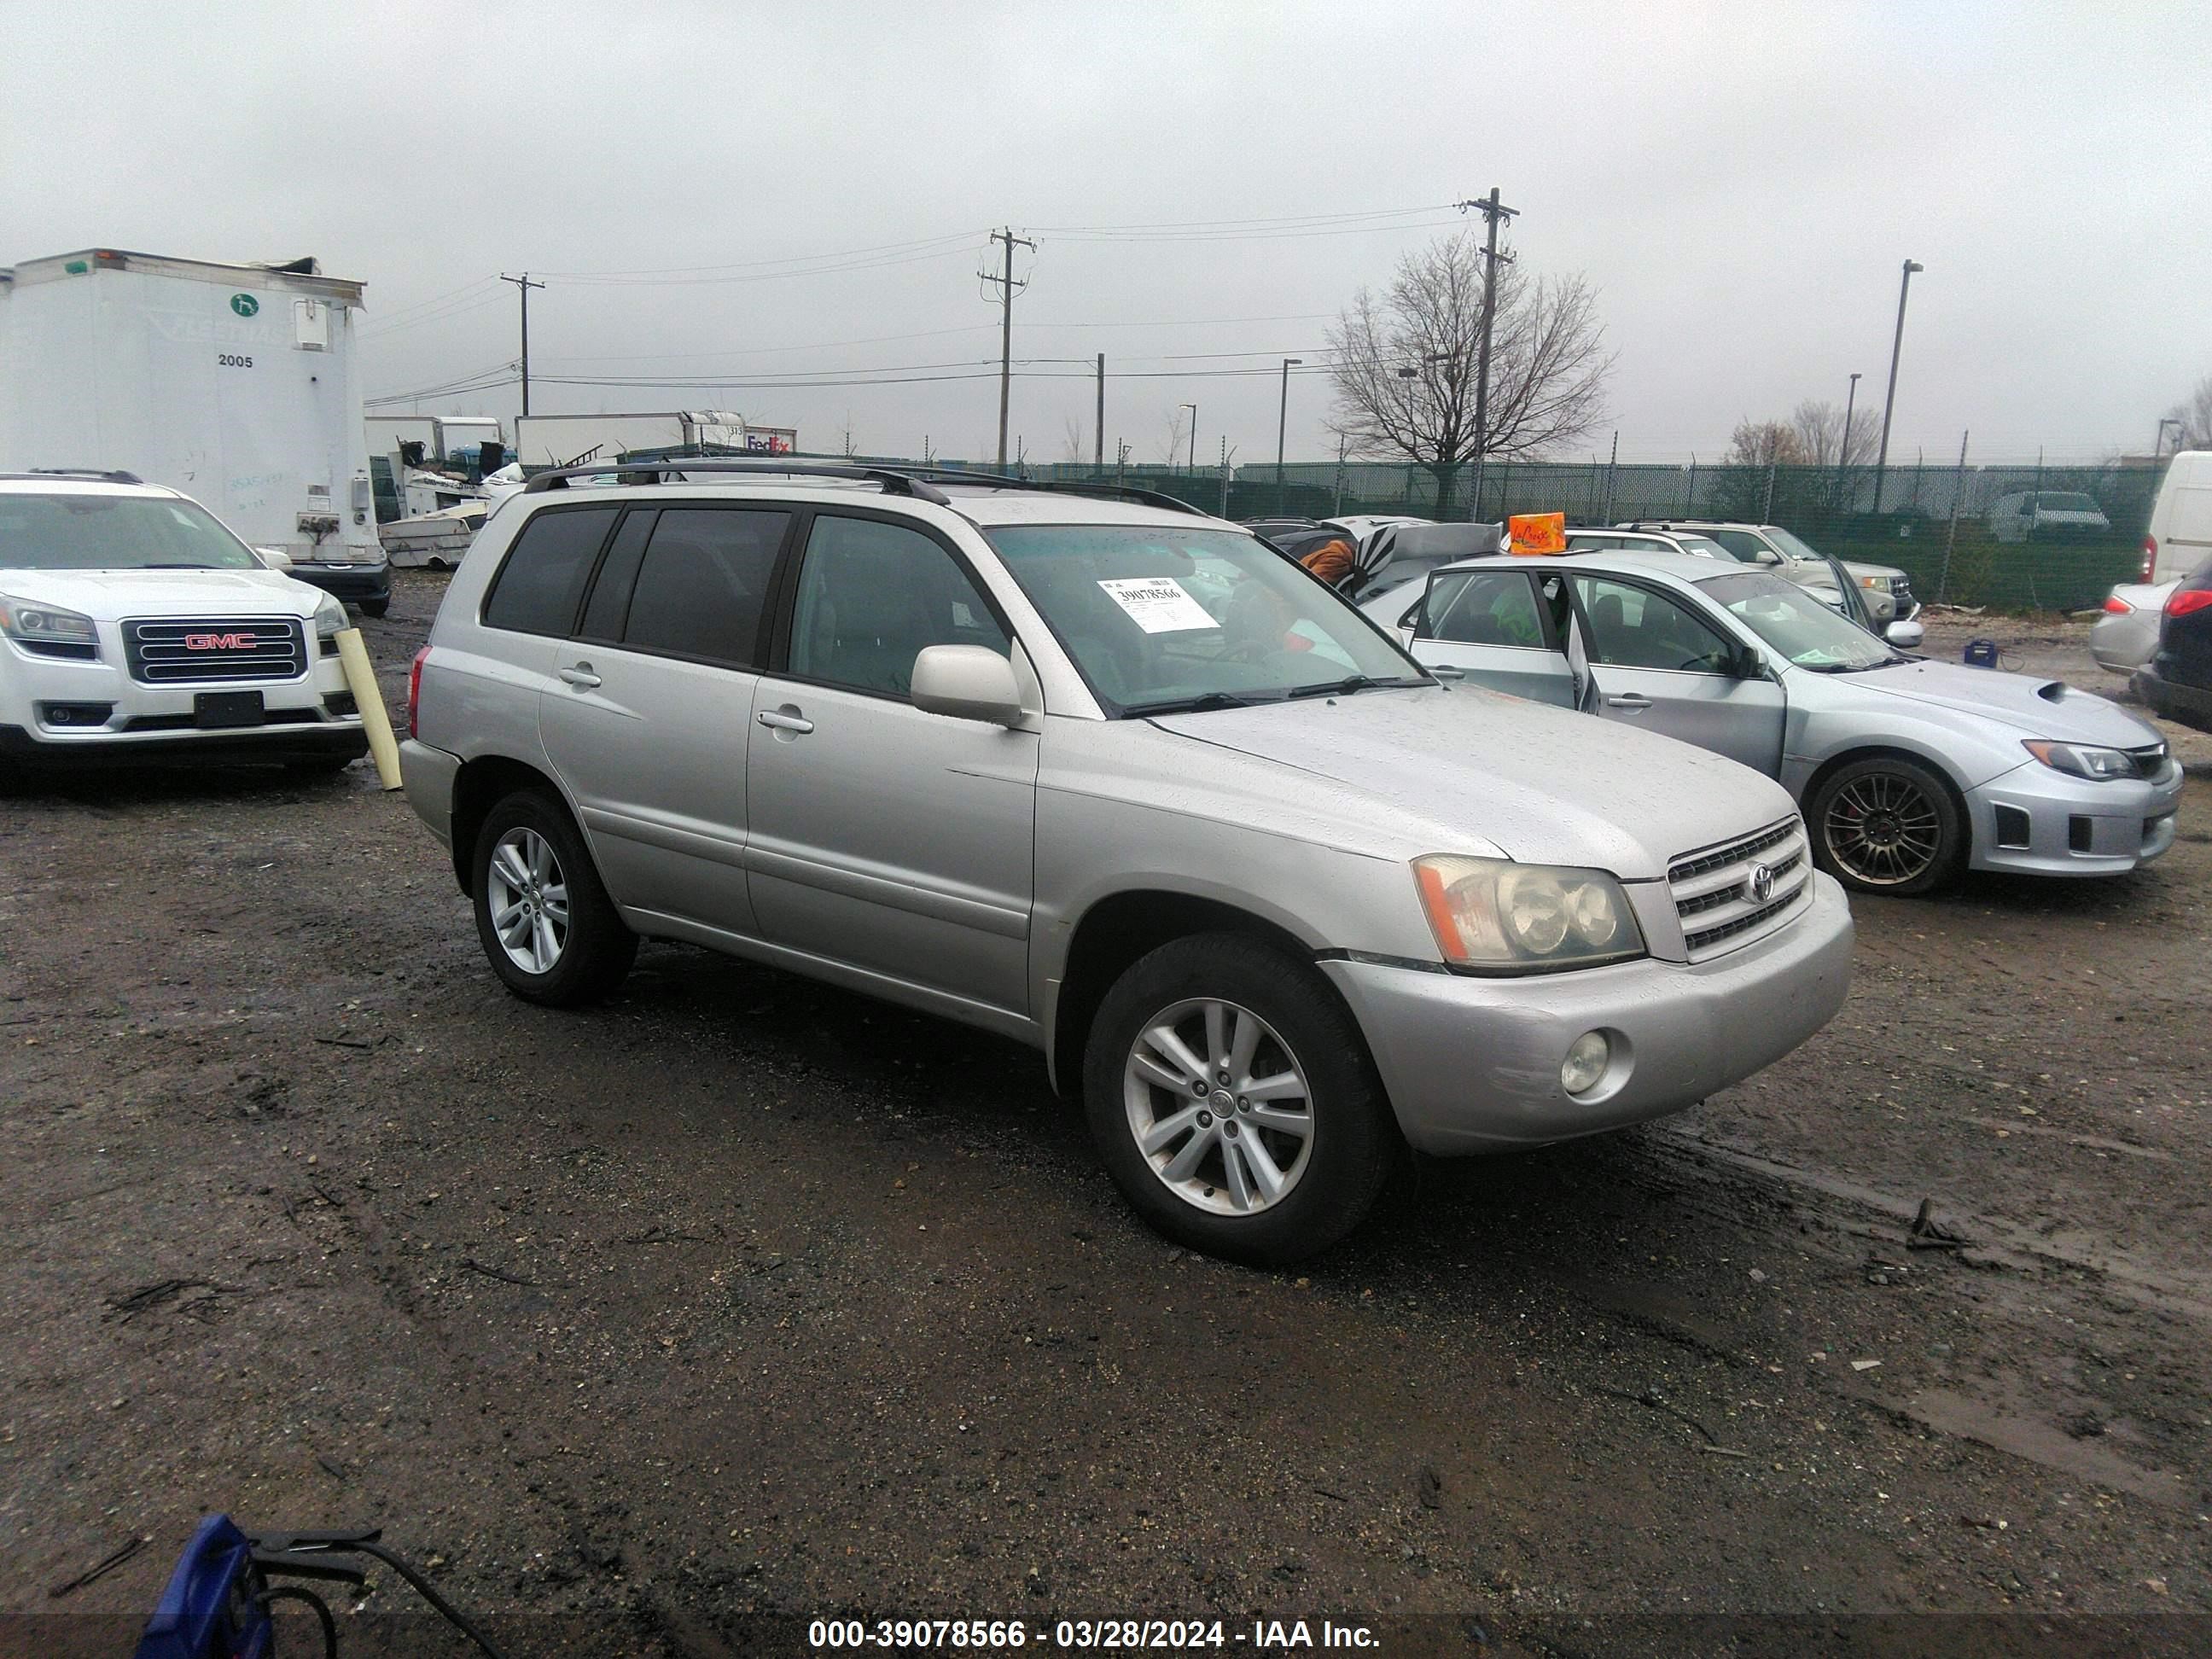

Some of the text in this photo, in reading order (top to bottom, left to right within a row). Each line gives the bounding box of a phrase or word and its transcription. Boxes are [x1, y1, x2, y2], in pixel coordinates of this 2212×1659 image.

[218, 353, 253, 368] 2005
[747, 435, 789, 451] FedEx
[1117, 588, 1181, 602] 39078566
[185, 633, 257, 649] GMC
